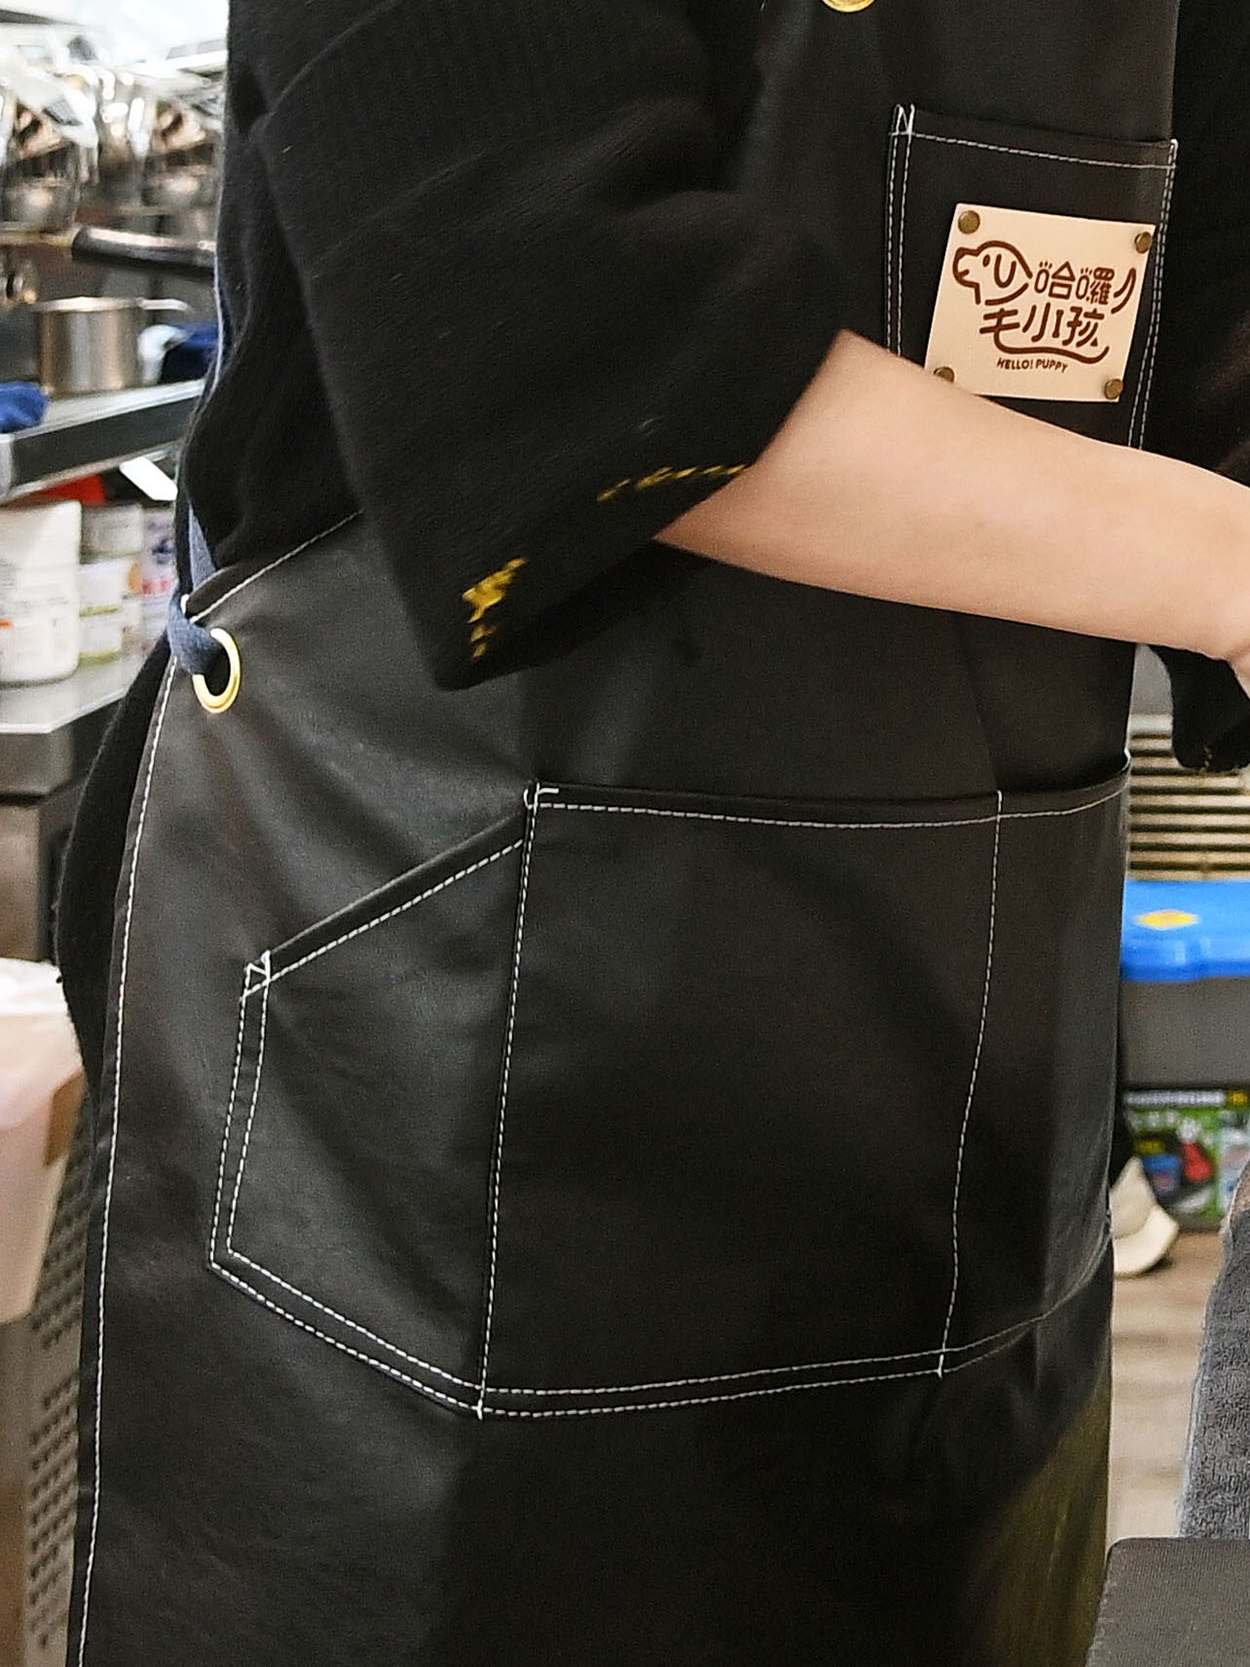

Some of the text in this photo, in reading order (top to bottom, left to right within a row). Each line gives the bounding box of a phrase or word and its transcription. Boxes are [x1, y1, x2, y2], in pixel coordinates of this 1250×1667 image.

[1033, 260, 1115, 305] 哈囉
[979, 301, 1109, 364] 毛小孩
[996, 357, 1068, 373] HELLO! PUPPY
